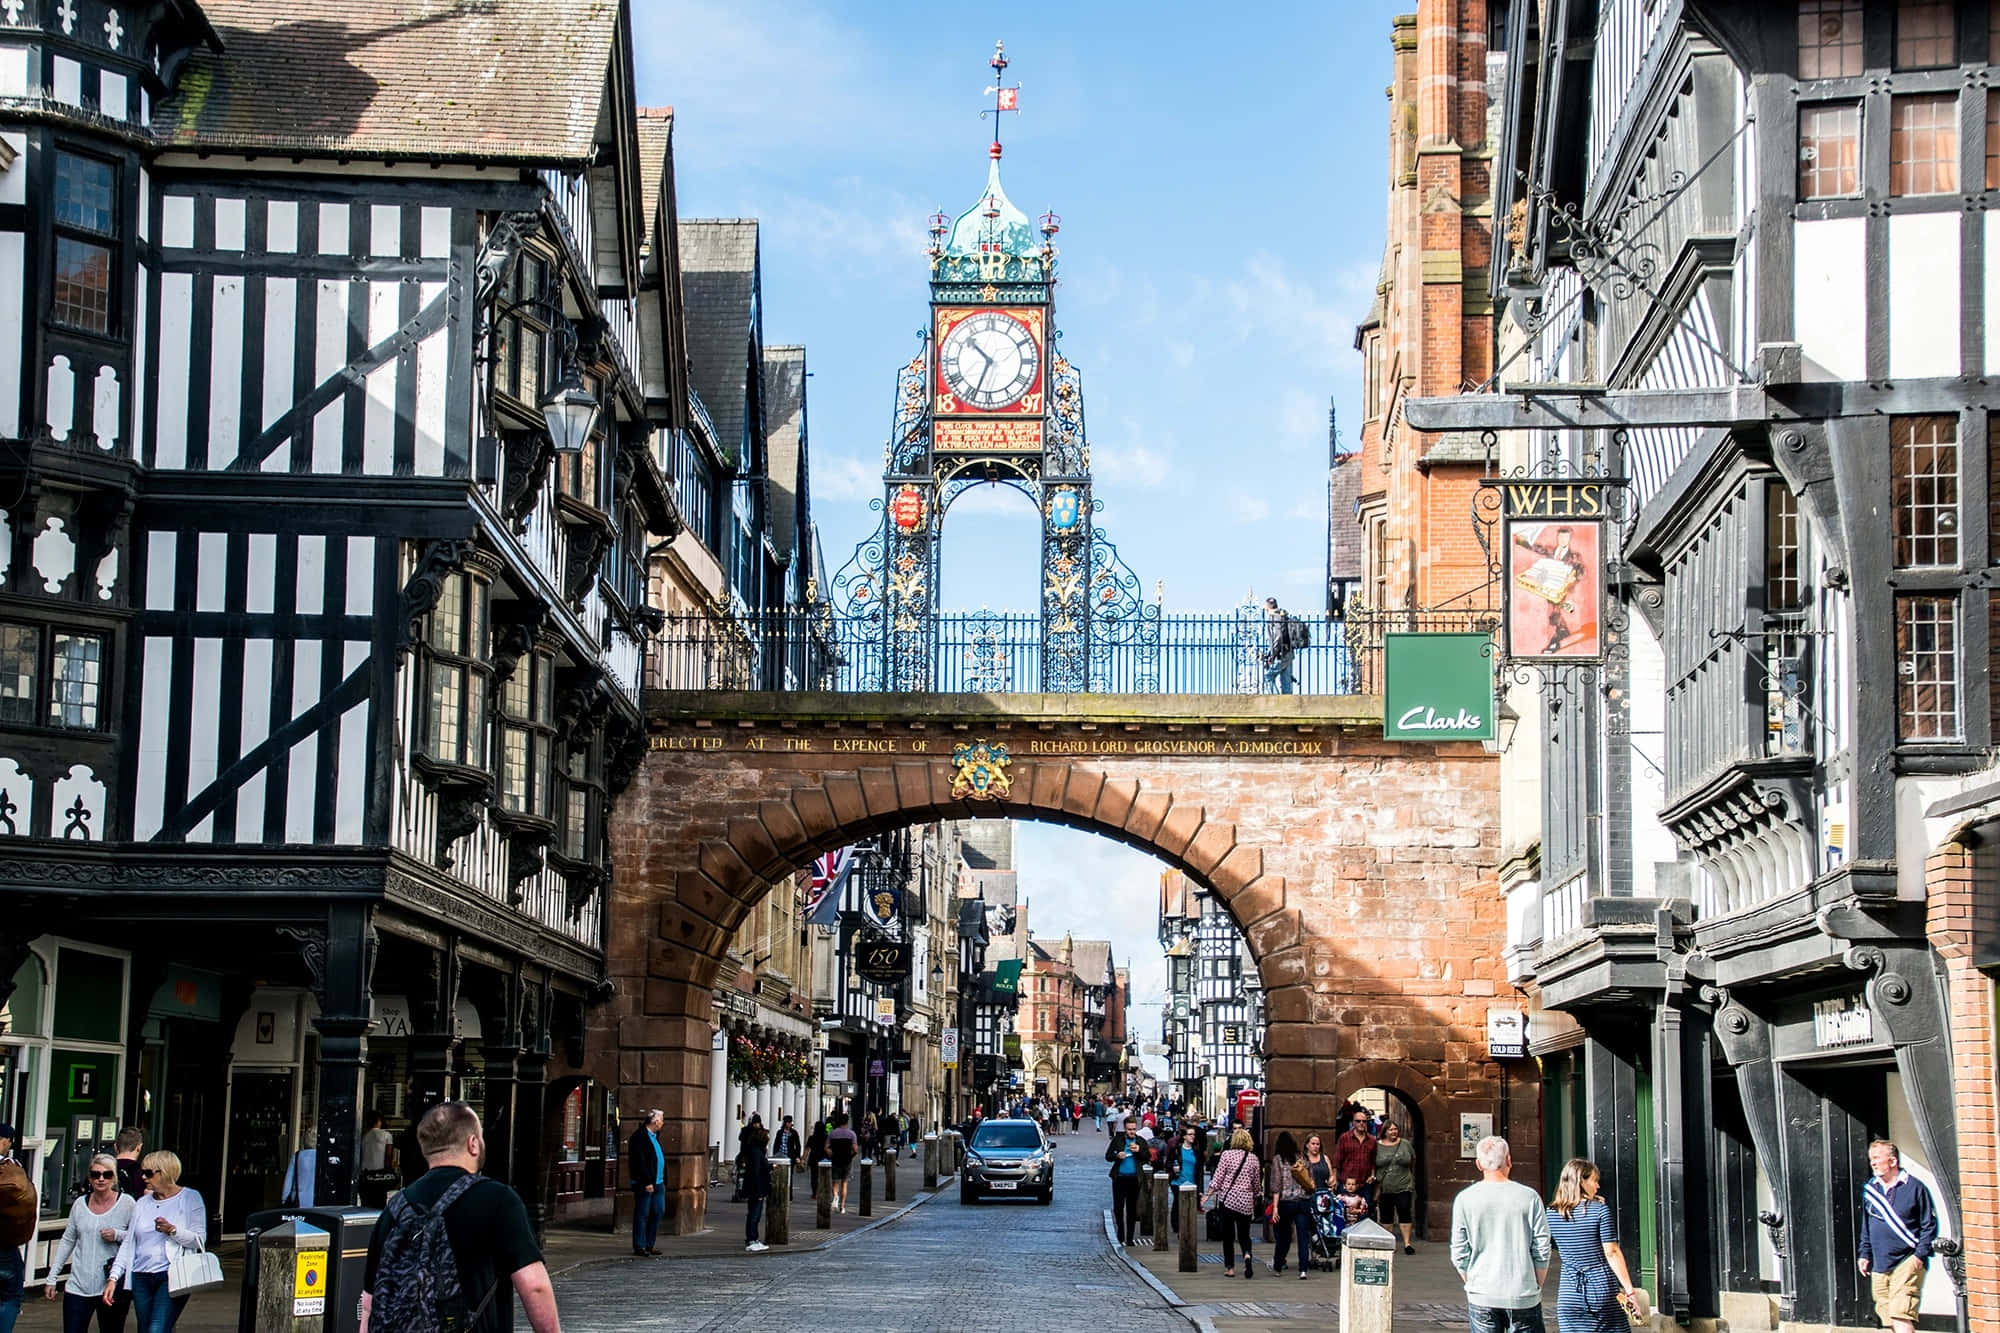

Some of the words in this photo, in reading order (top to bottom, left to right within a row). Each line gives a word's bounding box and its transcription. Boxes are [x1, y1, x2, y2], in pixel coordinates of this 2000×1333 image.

[936, 394, 956, 412] 18
[1020, 392, 1042, 412] 97
[1397, 706, 1481, 731] Clarks
[650, 737, 722, 750] ERECTED
[745, 738, 766, 750] AT
[784, 739, 812, 751] THE
[833, 739, 897, 752] EXPENCE
[912, 740, 930, 752] OF
[1031, 740, 1088, 753] RICHARD
[1092, 741, 1127, 753] LORD
[1134, 741, 1216, 754] GROSVENOR
[868, 949, 899, 966] 150
[1492, 1046, 1507, 1054] SOLD
[1507, 1046, 1521, 1054] HERE
